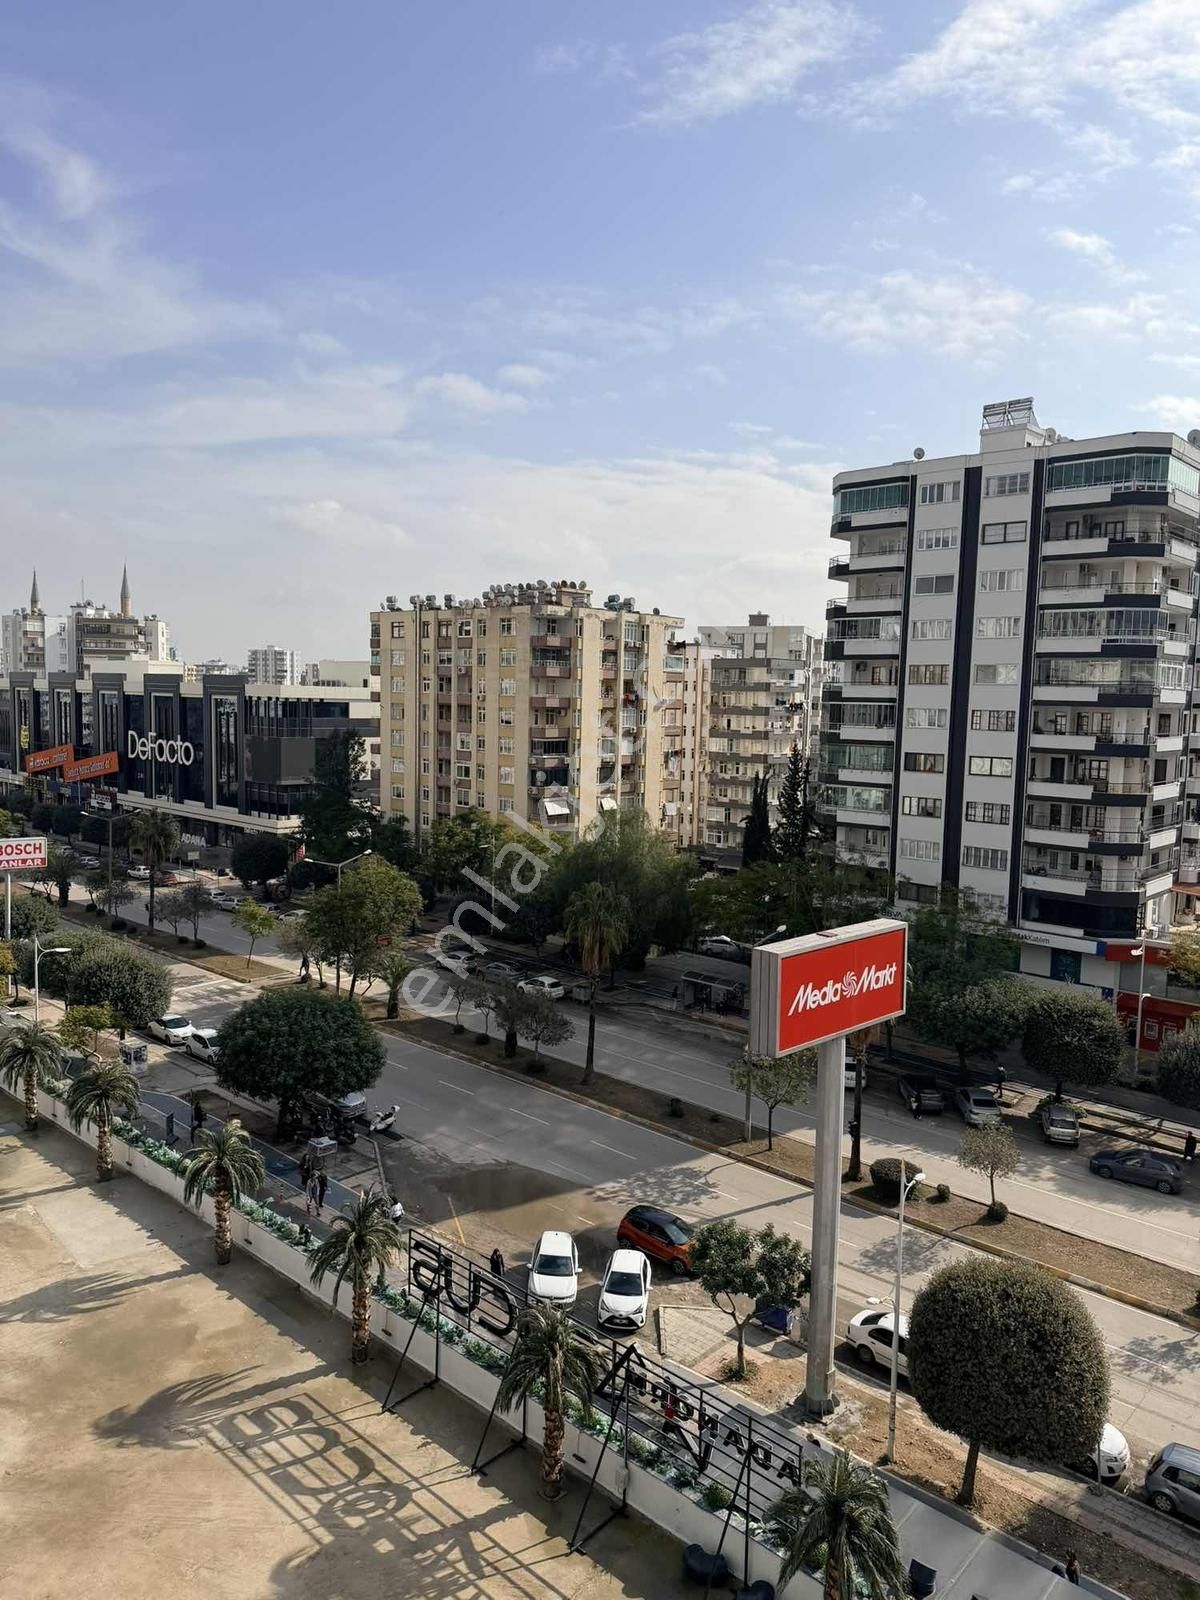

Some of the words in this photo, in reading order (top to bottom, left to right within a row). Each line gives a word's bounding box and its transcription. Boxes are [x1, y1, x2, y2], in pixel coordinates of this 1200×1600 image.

[128, 730, 194, 766] DeFacto
[787, 980, 842, 1016] Media
[854, 962, 897, 996] Markt
